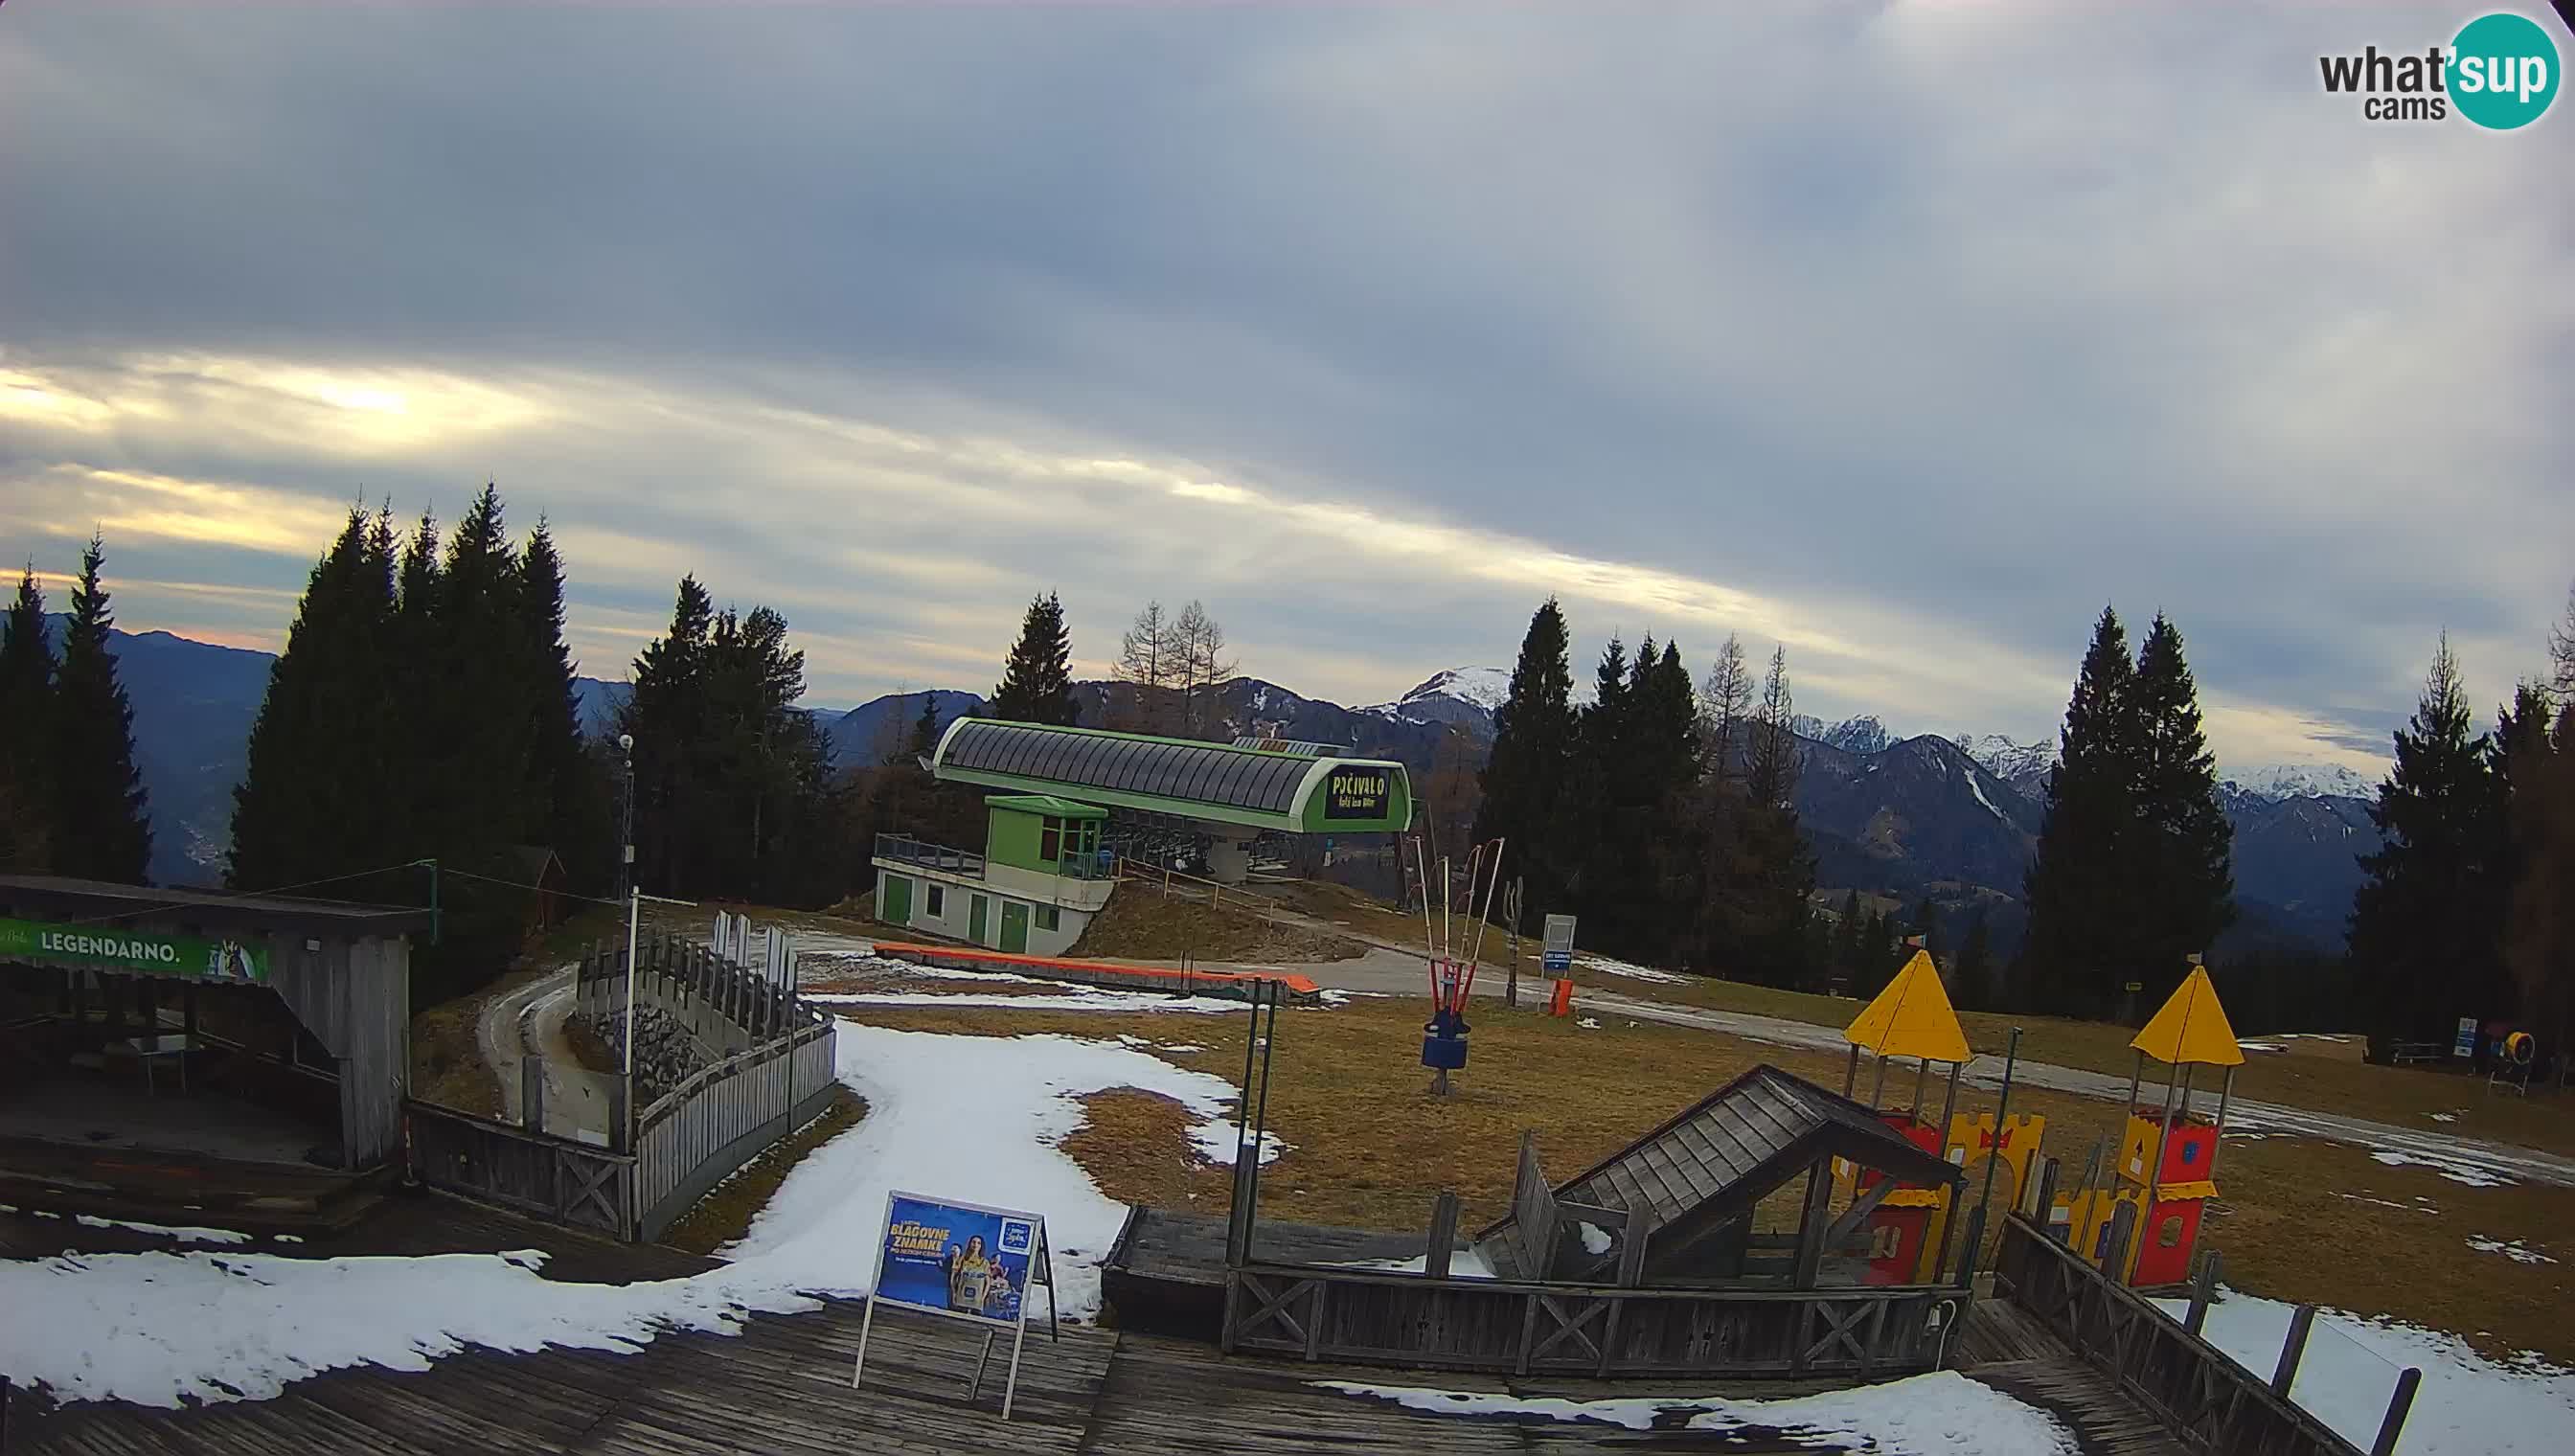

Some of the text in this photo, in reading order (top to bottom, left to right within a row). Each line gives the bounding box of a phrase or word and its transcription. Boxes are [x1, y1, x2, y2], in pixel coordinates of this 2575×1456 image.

[41, 931, 180, 963] LEGENDARNO.
[891, 1223, 950, 1240] BLAGOVNE
[894, 1237, 943, 1251] ZNAMKE
